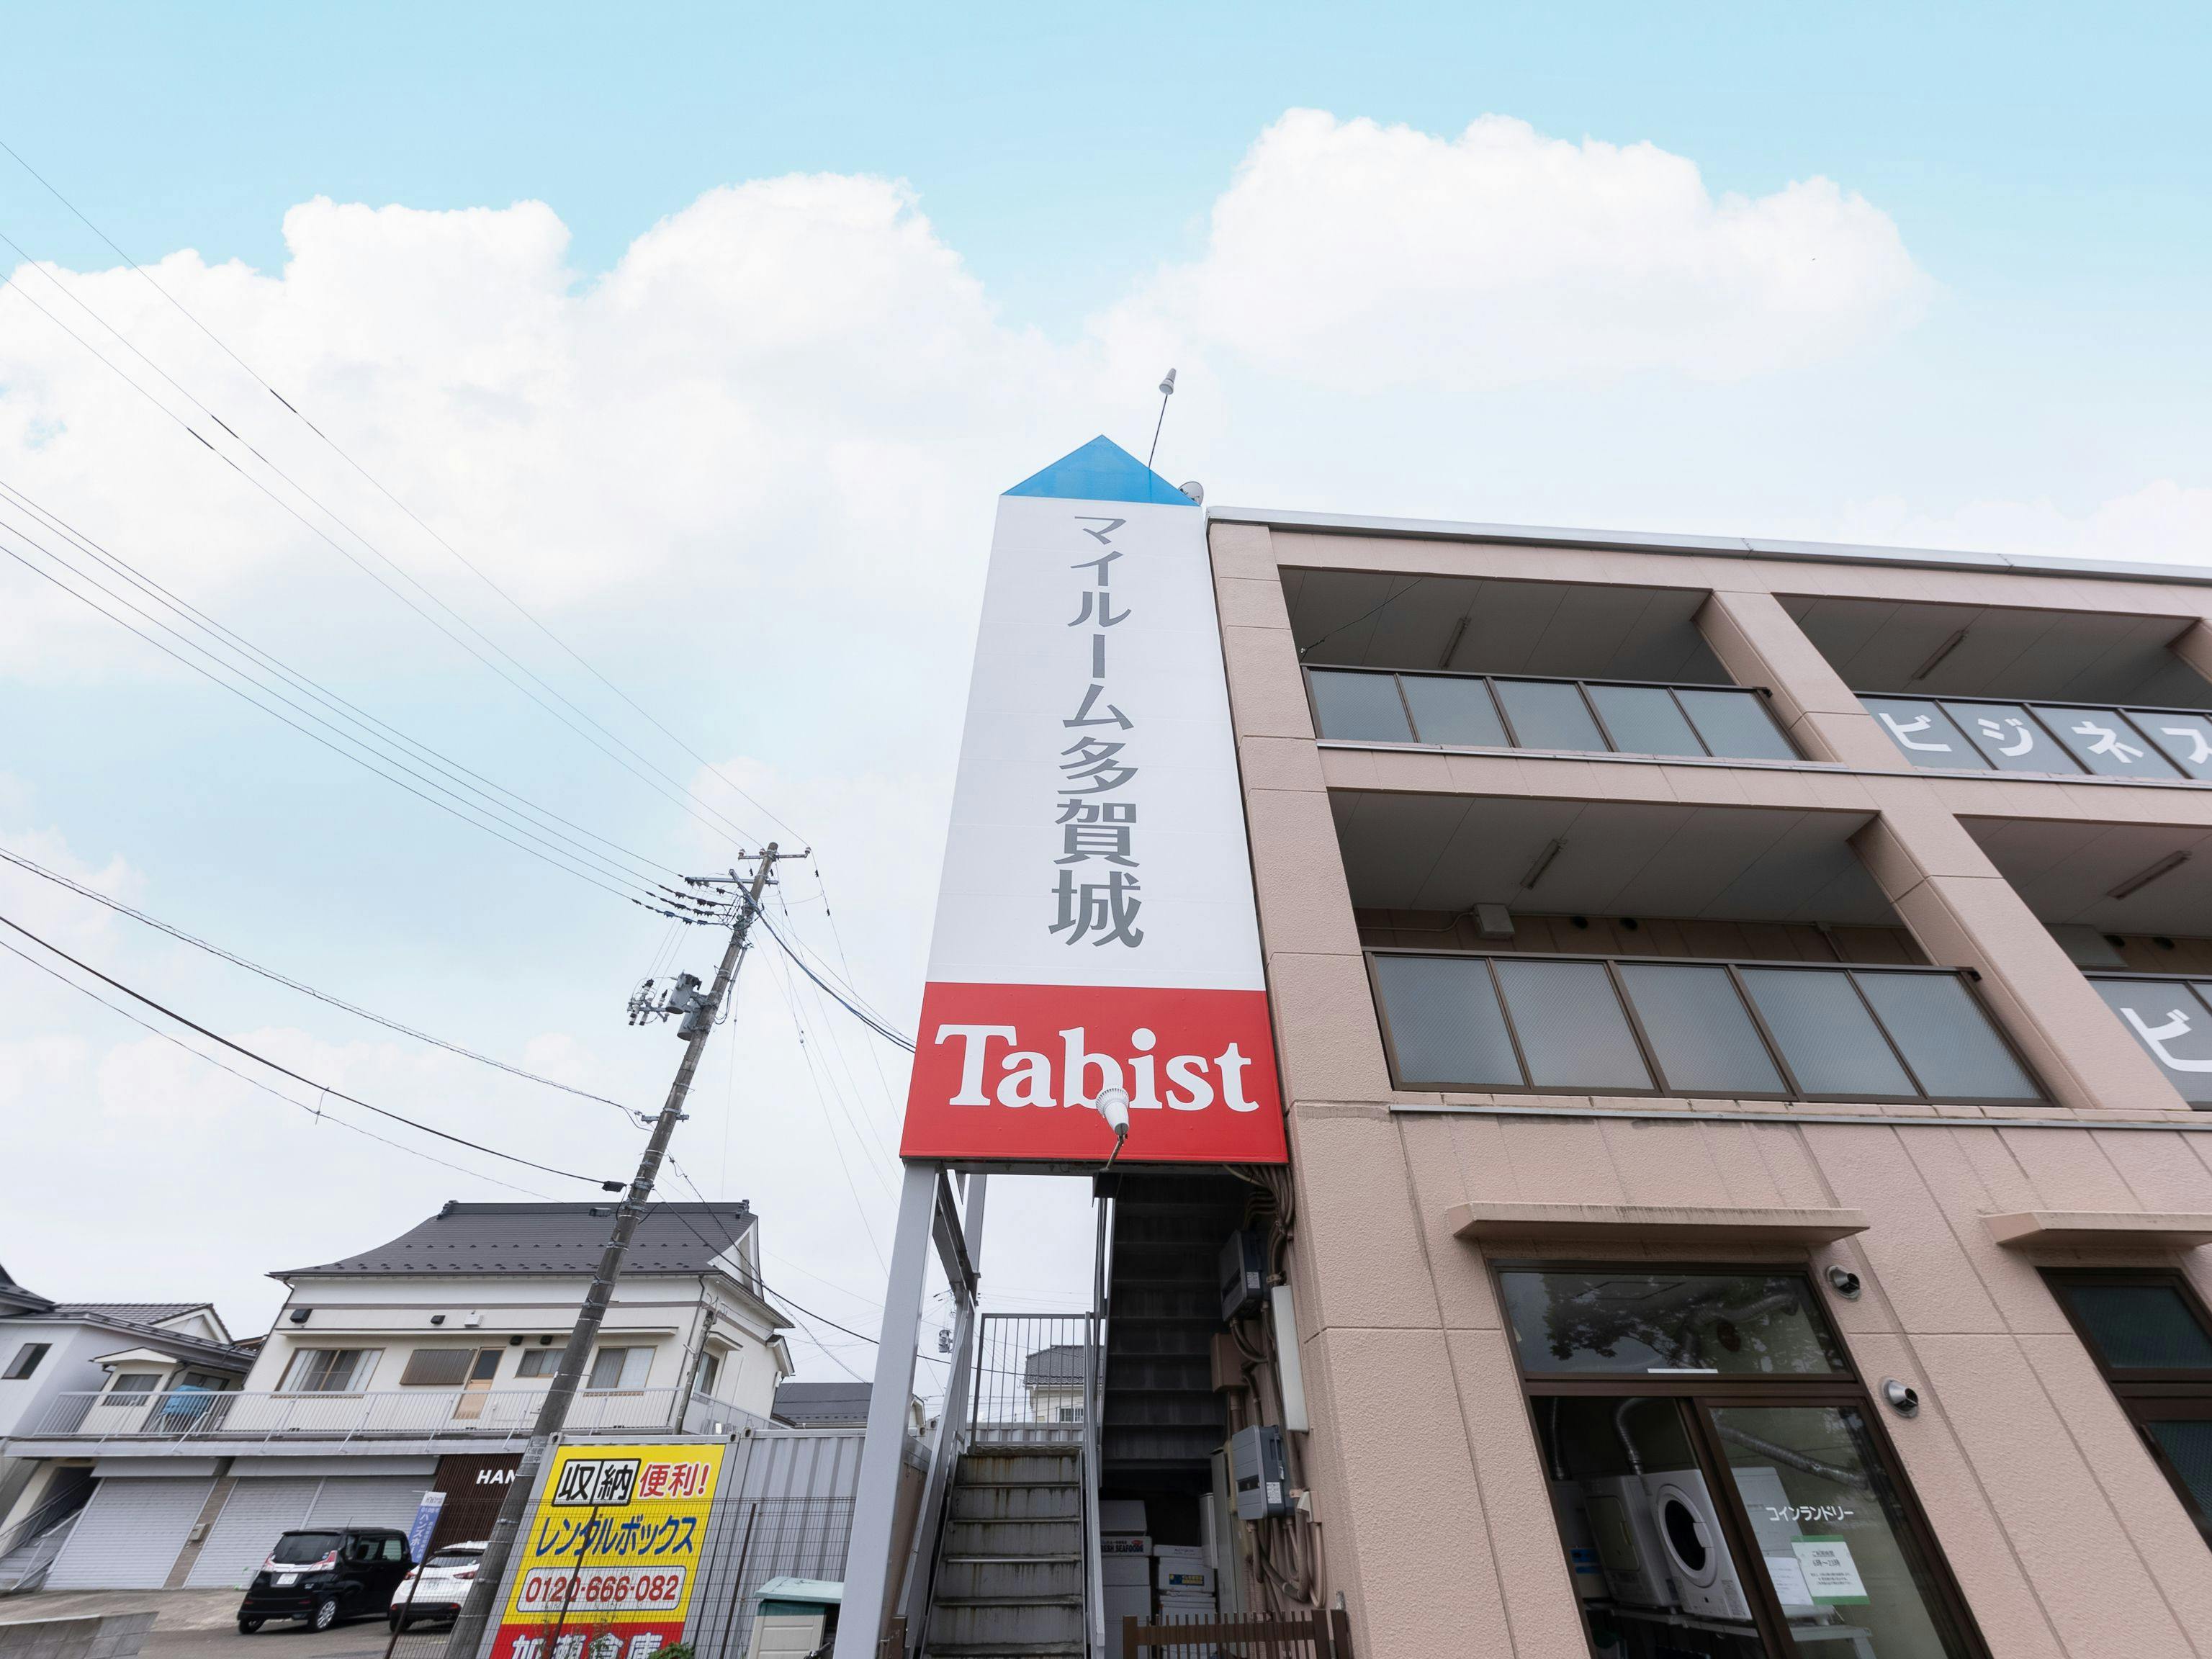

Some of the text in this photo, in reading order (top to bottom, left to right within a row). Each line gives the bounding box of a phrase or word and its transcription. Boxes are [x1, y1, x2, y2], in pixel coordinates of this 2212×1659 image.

[1049, 516, 1144, 948] マイルーム多賀城
[1879, 712, 2212, 764] ビジネス
[2119, 1007, 2212, 1073] ビ
[935, 1023, 1260, 1112] Tabist
[558, 1464, 634, 1501] 収納
[536, 1514, 697, 1557] レンタルボックス
[1766, 1506, 1854, 1521] コインランドリー
